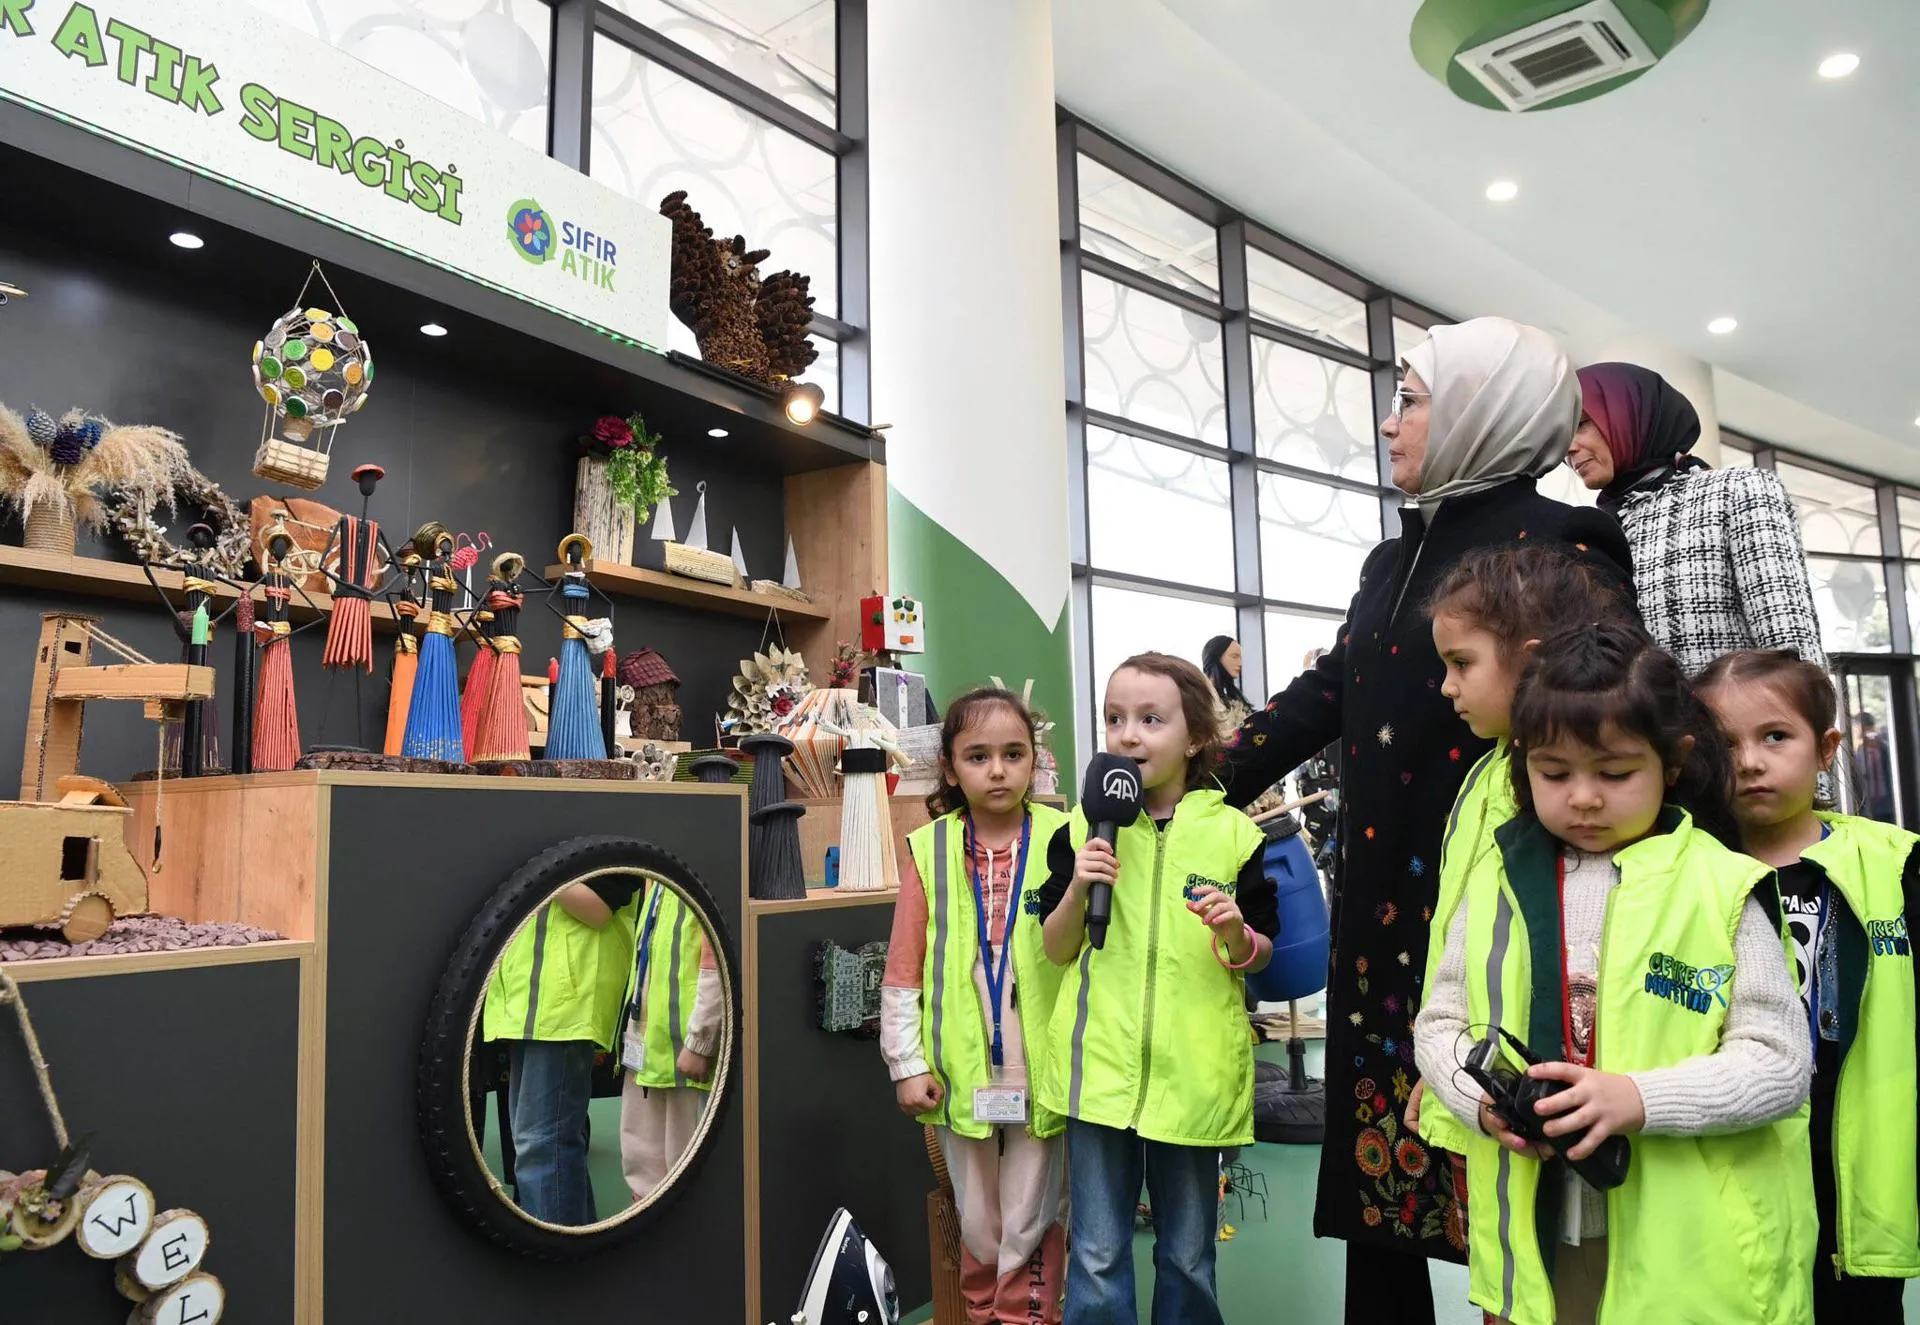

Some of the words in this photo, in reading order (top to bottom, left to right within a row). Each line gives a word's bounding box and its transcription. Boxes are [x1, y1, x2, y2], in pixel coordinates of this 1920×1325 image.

[51, 1, 224, 116] ATIK
[239, 82, 463, 226] SERGİSİ
[562, 220, 617, 266] SIFIR
[561, 248, 617, 293] ATIK
[1104, 778, 1135, 803] AA
